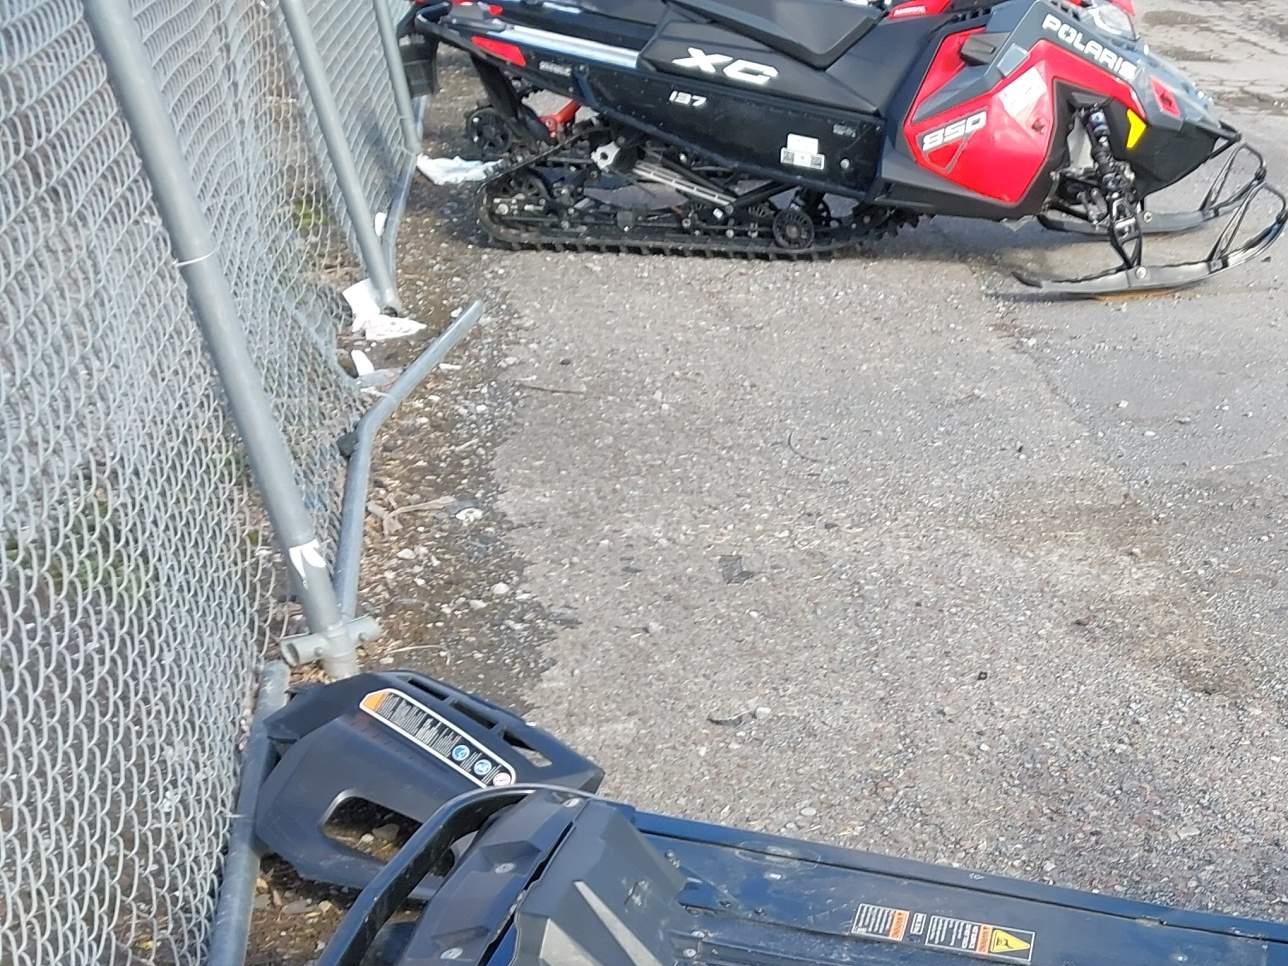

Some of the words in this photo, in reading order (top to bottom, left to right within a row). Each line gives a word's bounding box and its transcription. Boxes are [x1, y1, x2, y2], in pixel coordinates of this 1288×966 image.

[672, 47, 779, 85] XC
[1042, 14, 1139, 81] POLARIS
[922, 111, 987, 150] 850
